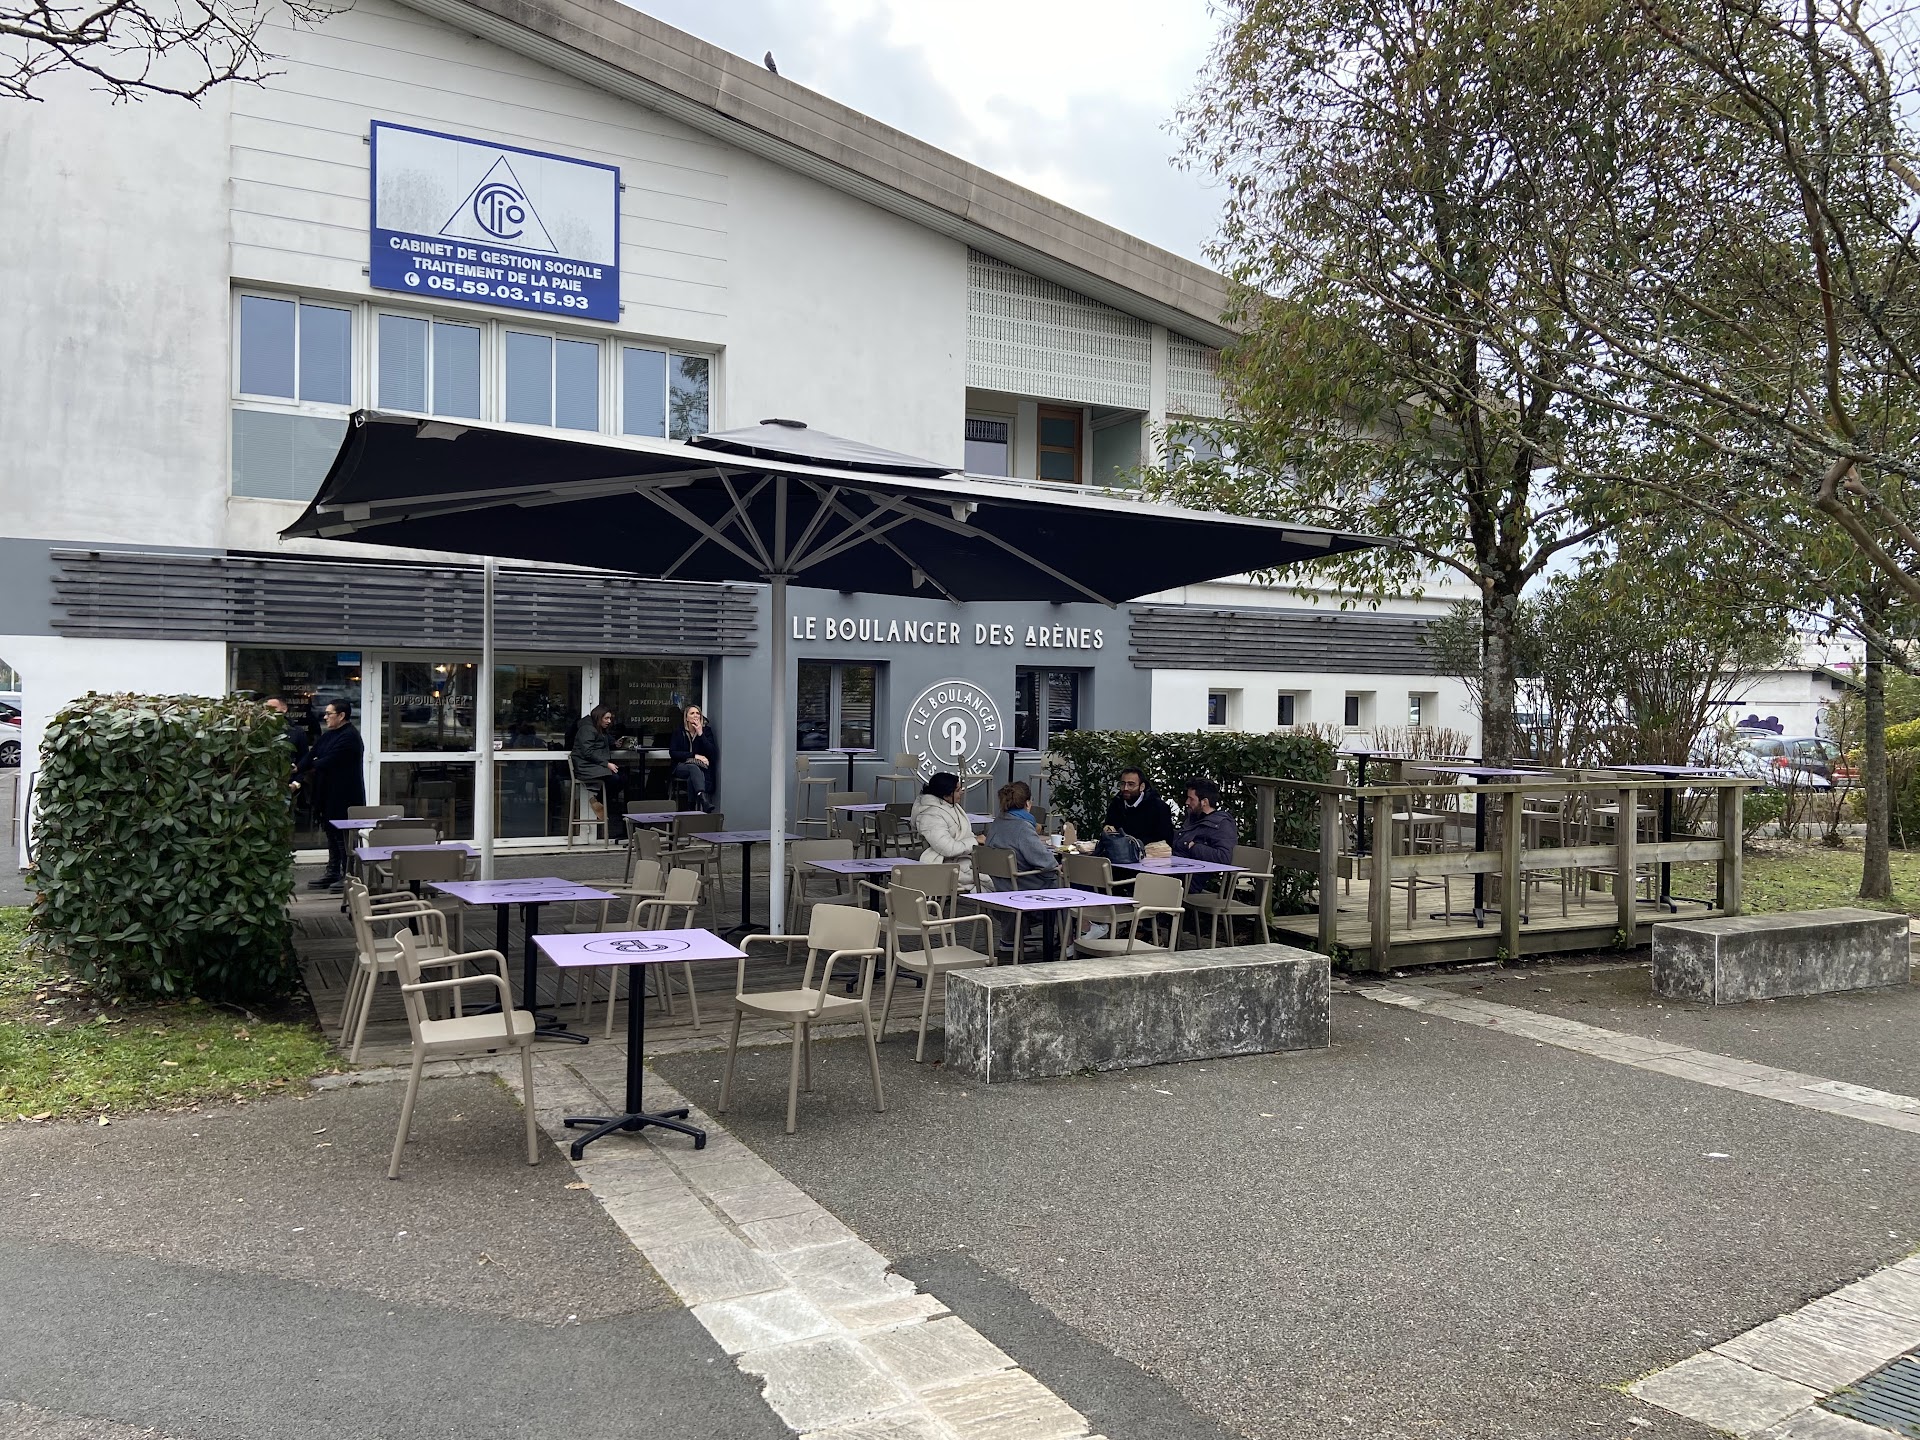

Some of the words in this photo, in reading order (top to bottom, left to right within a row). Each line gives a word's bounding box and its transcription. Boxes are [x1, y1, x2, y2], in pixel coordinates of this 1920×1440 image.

[389, 236, 453, 257] CABINET
[457, 247, 477, 261] DE
[481, 250, 541, 271] GESTION
[544, 260, 602, 280] SOCIALE
[412, 256, 504, 281] TRAITEMENT
[507, 270, 527, 285] DE
[530, 274, 549, 288] LA
[552, 276, 582, 292] PAIE
[427, 275, 589, 310] 05.59.03.15.93
[792, 615, 816, 640] LE
[825, 617, 961, 644] BOULANGER
[975, 623, 1015, 646] DES
[1024, 622, 1104, 649] ARÈNES
[392, 695, 406, 706] DU
[408, 695, 467, 707] BOULANGER
[913, 707, 931, 726] LE
[928, 688, 997, 732] BOULANGER
[941, 716, 967, 756] B
[918, 751, 937, 776] DES
